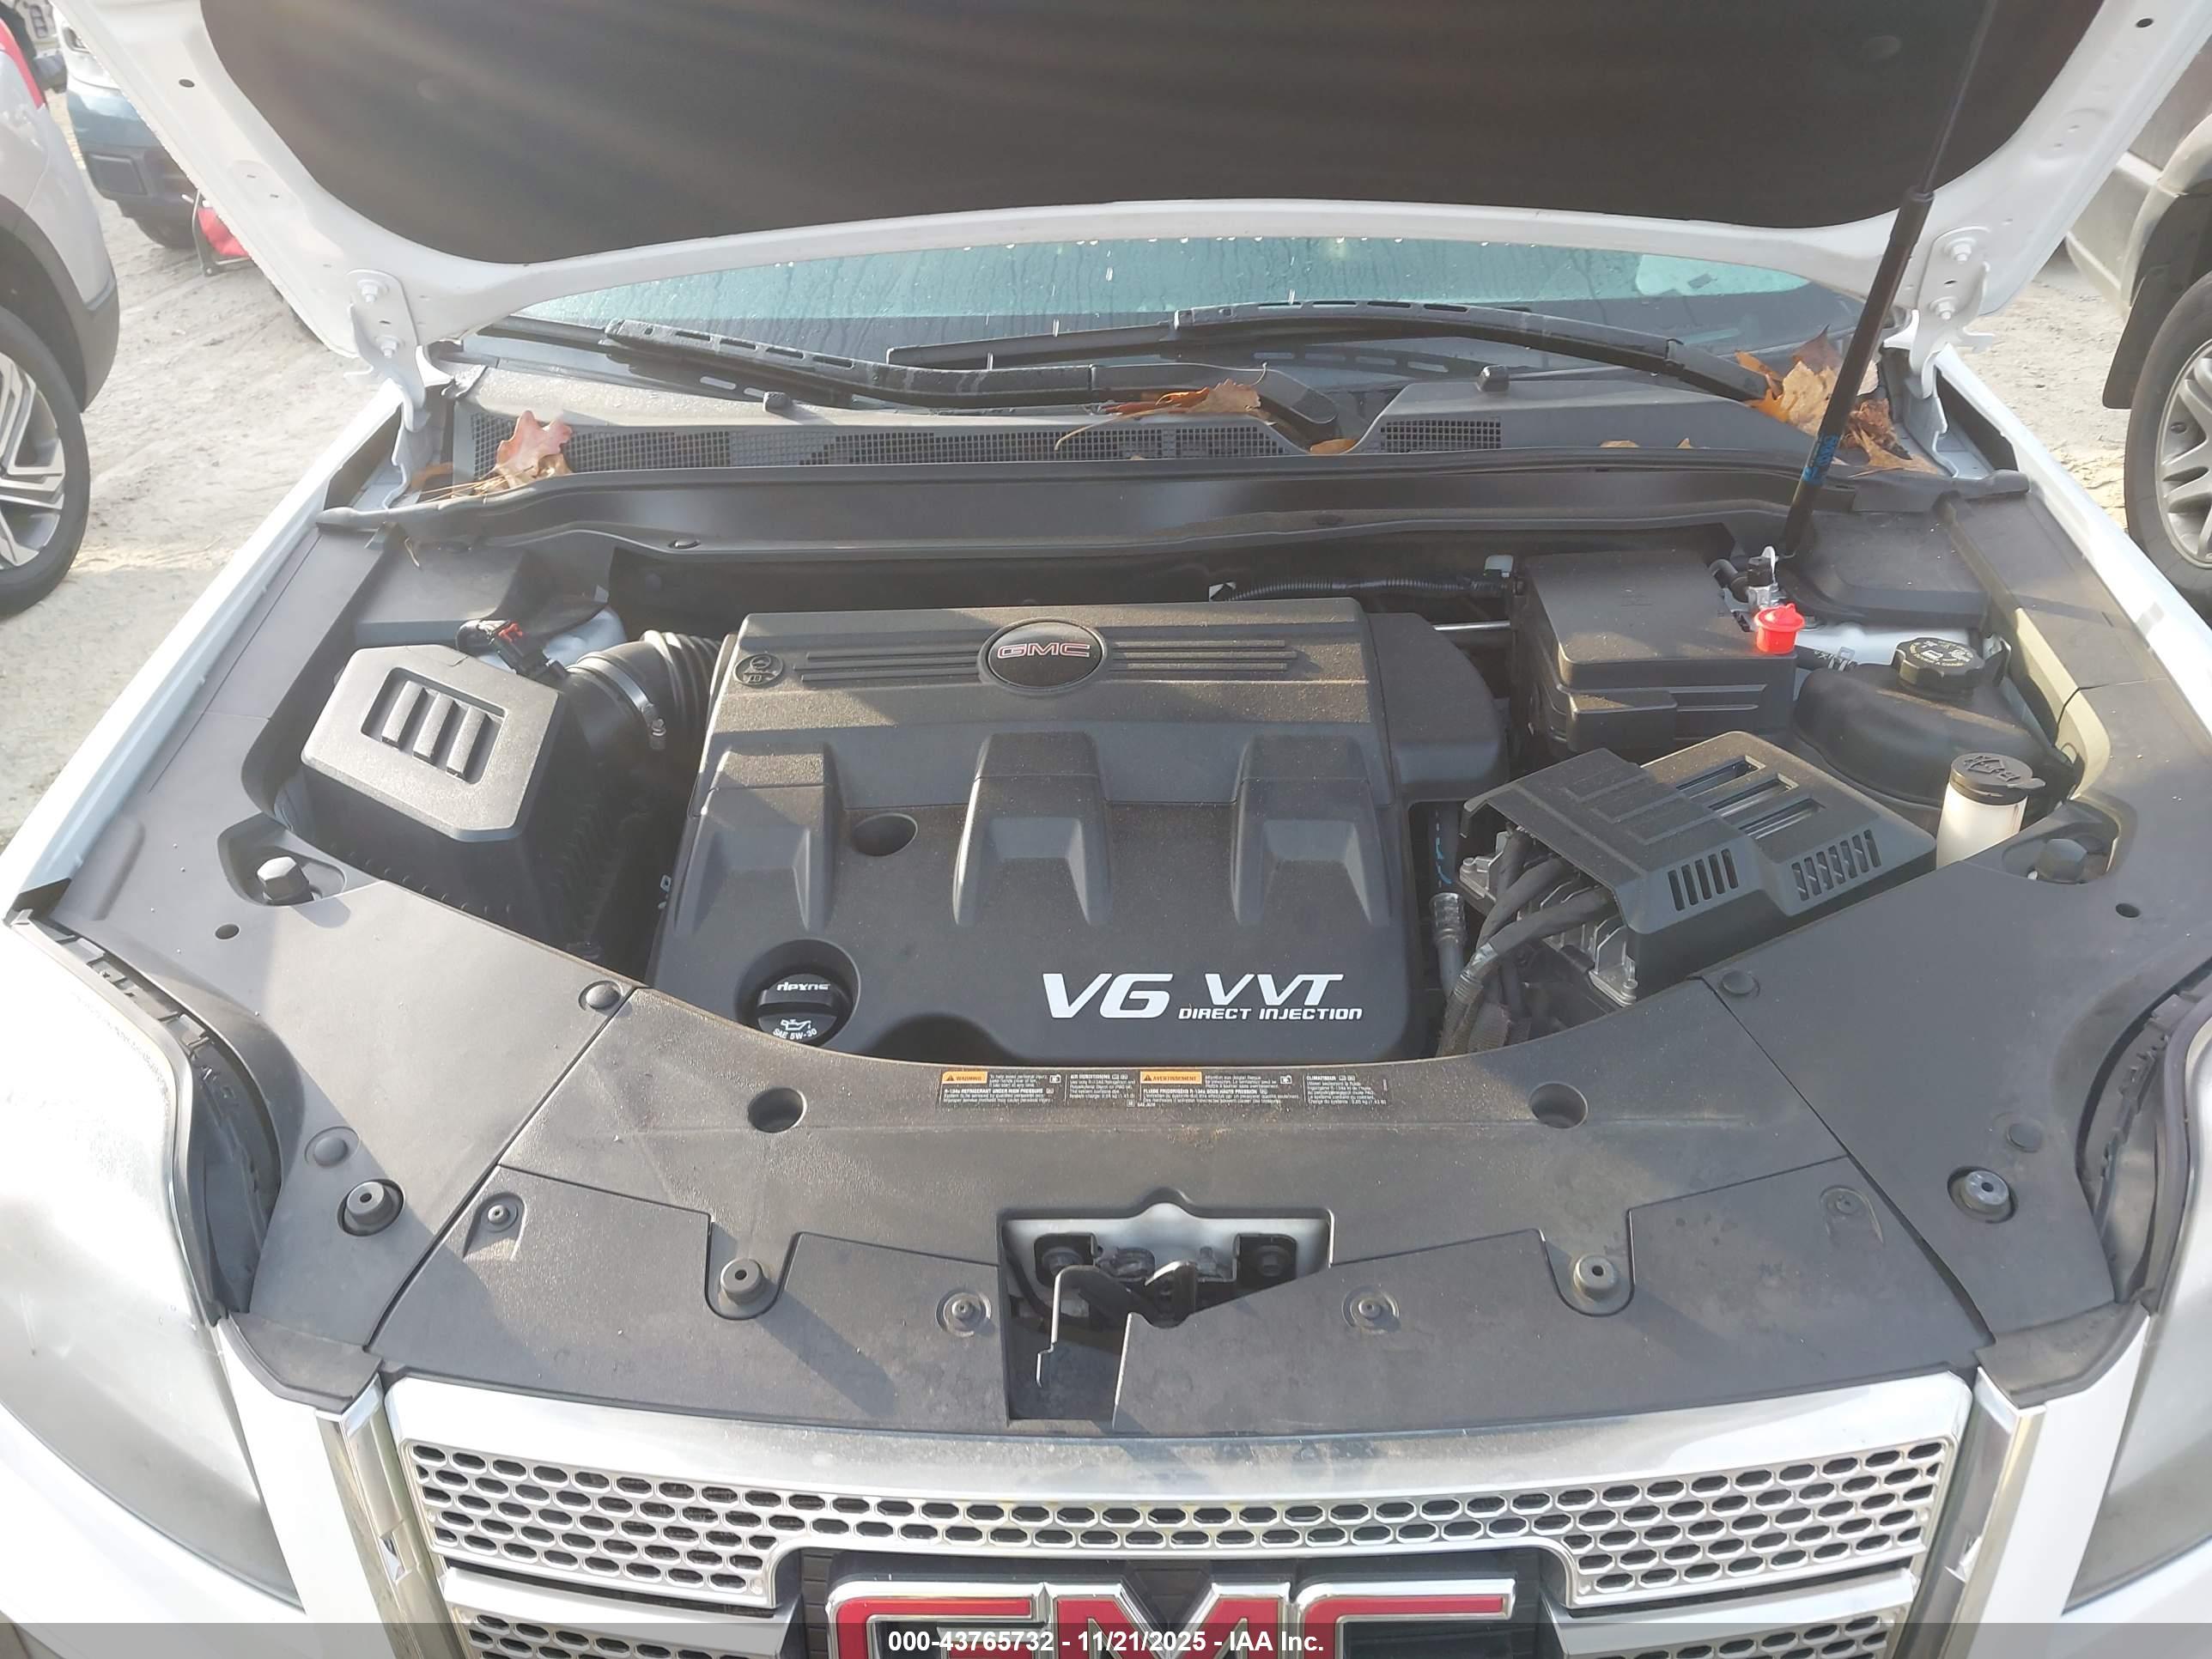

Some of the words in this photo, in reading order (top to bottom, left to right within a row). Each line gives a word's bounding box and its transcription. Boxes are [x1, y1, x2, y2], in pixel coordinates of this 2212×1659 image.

[997, 642, 1090, 659] GMC
[1042, 973, 1174, 1018] V6
[1205, 973, 1344, 1006] VVT
[1178, 1008, 1252, 1020] DIRECT
[1259, 1008, 1363, 1020] INJECTION
[790, 1028, 817, 1040] 5W-30
